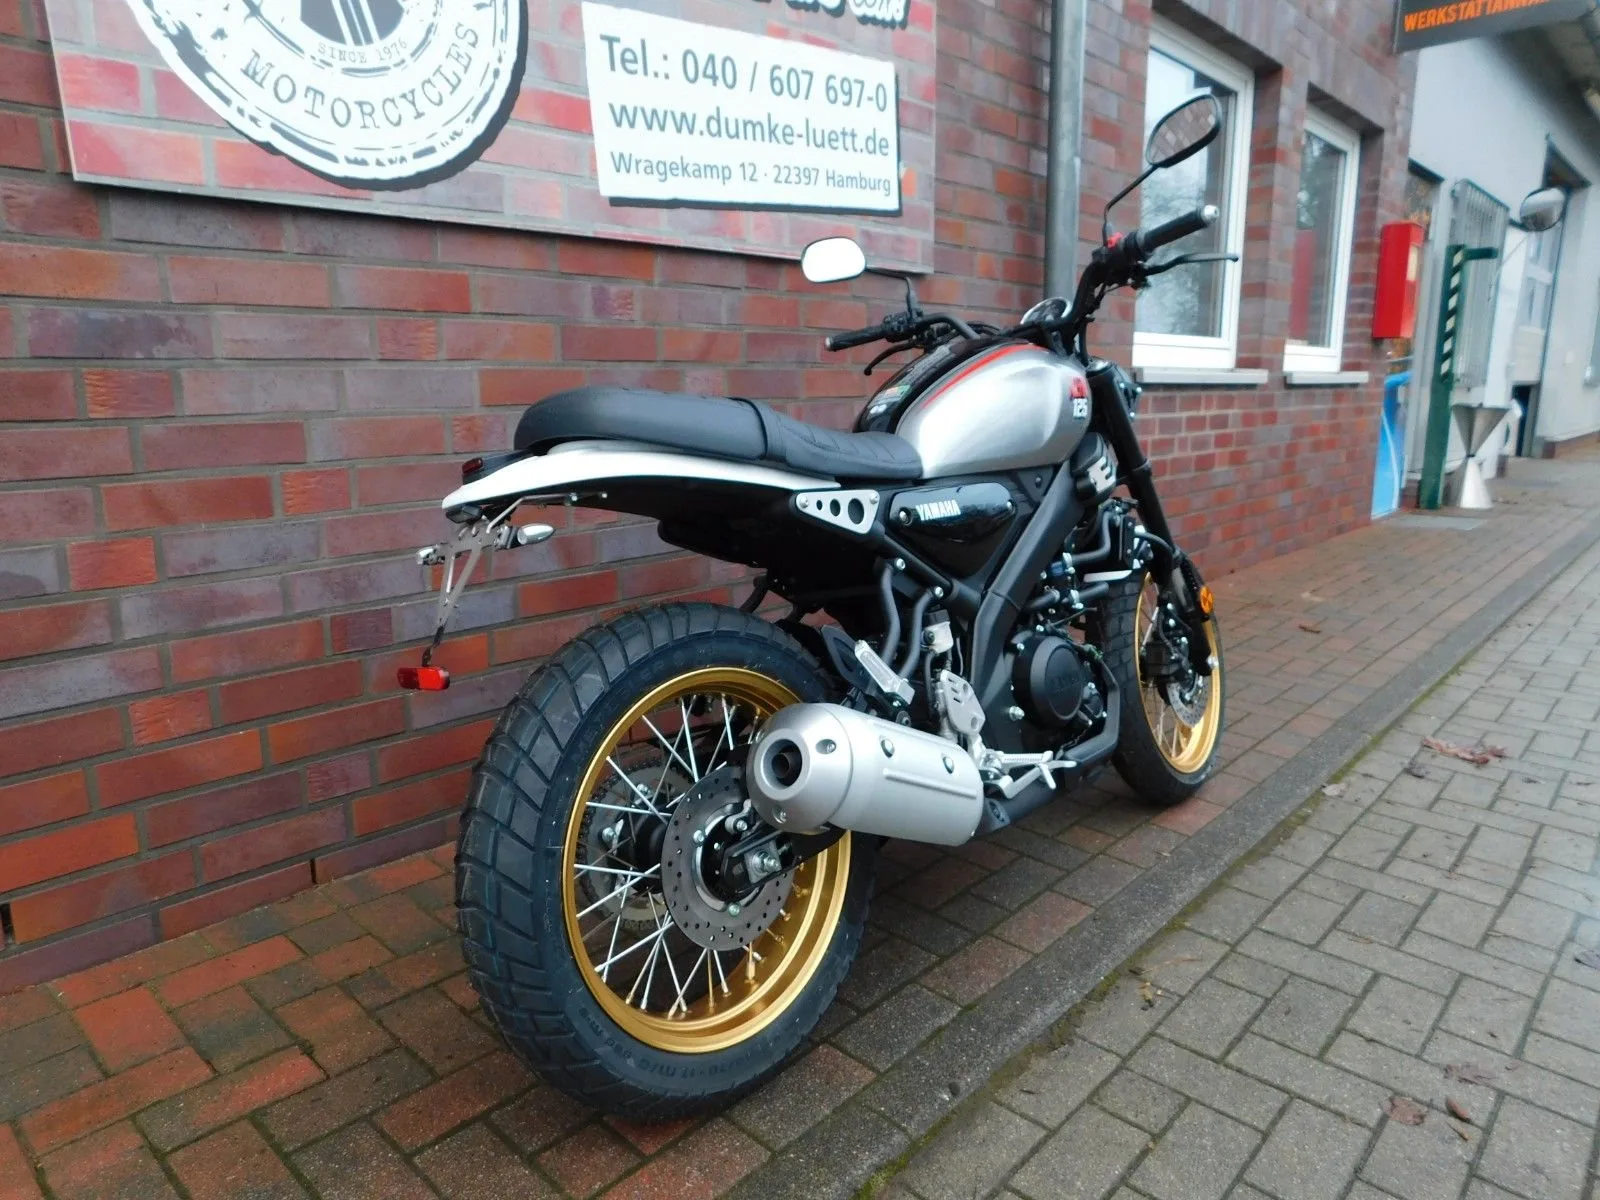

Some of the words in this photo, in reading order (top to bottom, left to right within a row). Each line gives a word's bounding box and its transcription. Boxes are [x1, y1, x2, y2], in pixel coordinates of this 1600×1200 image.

[240, 21, 479, 129] MOTORCYCLES
[317, 41, 367, 63] SINCE
[375, 38, 409, 61] 1976
[600, 34, 670, 79] Tel.:
[682, 49, 737, 89] 040
[769, 64, 814, 100] 607
[825, 74, 887, 112] 697-0
[608, 102, 890, 156] www.dumke-luett.de
[610, 151, 732, 184] Wragekamp
[739, 162, 759, 182] 12
[773, 165, 820, 186] 22397
[825, 171, 891, 196] Hamburg
[915, 499, 961, 522] YAMAHA
